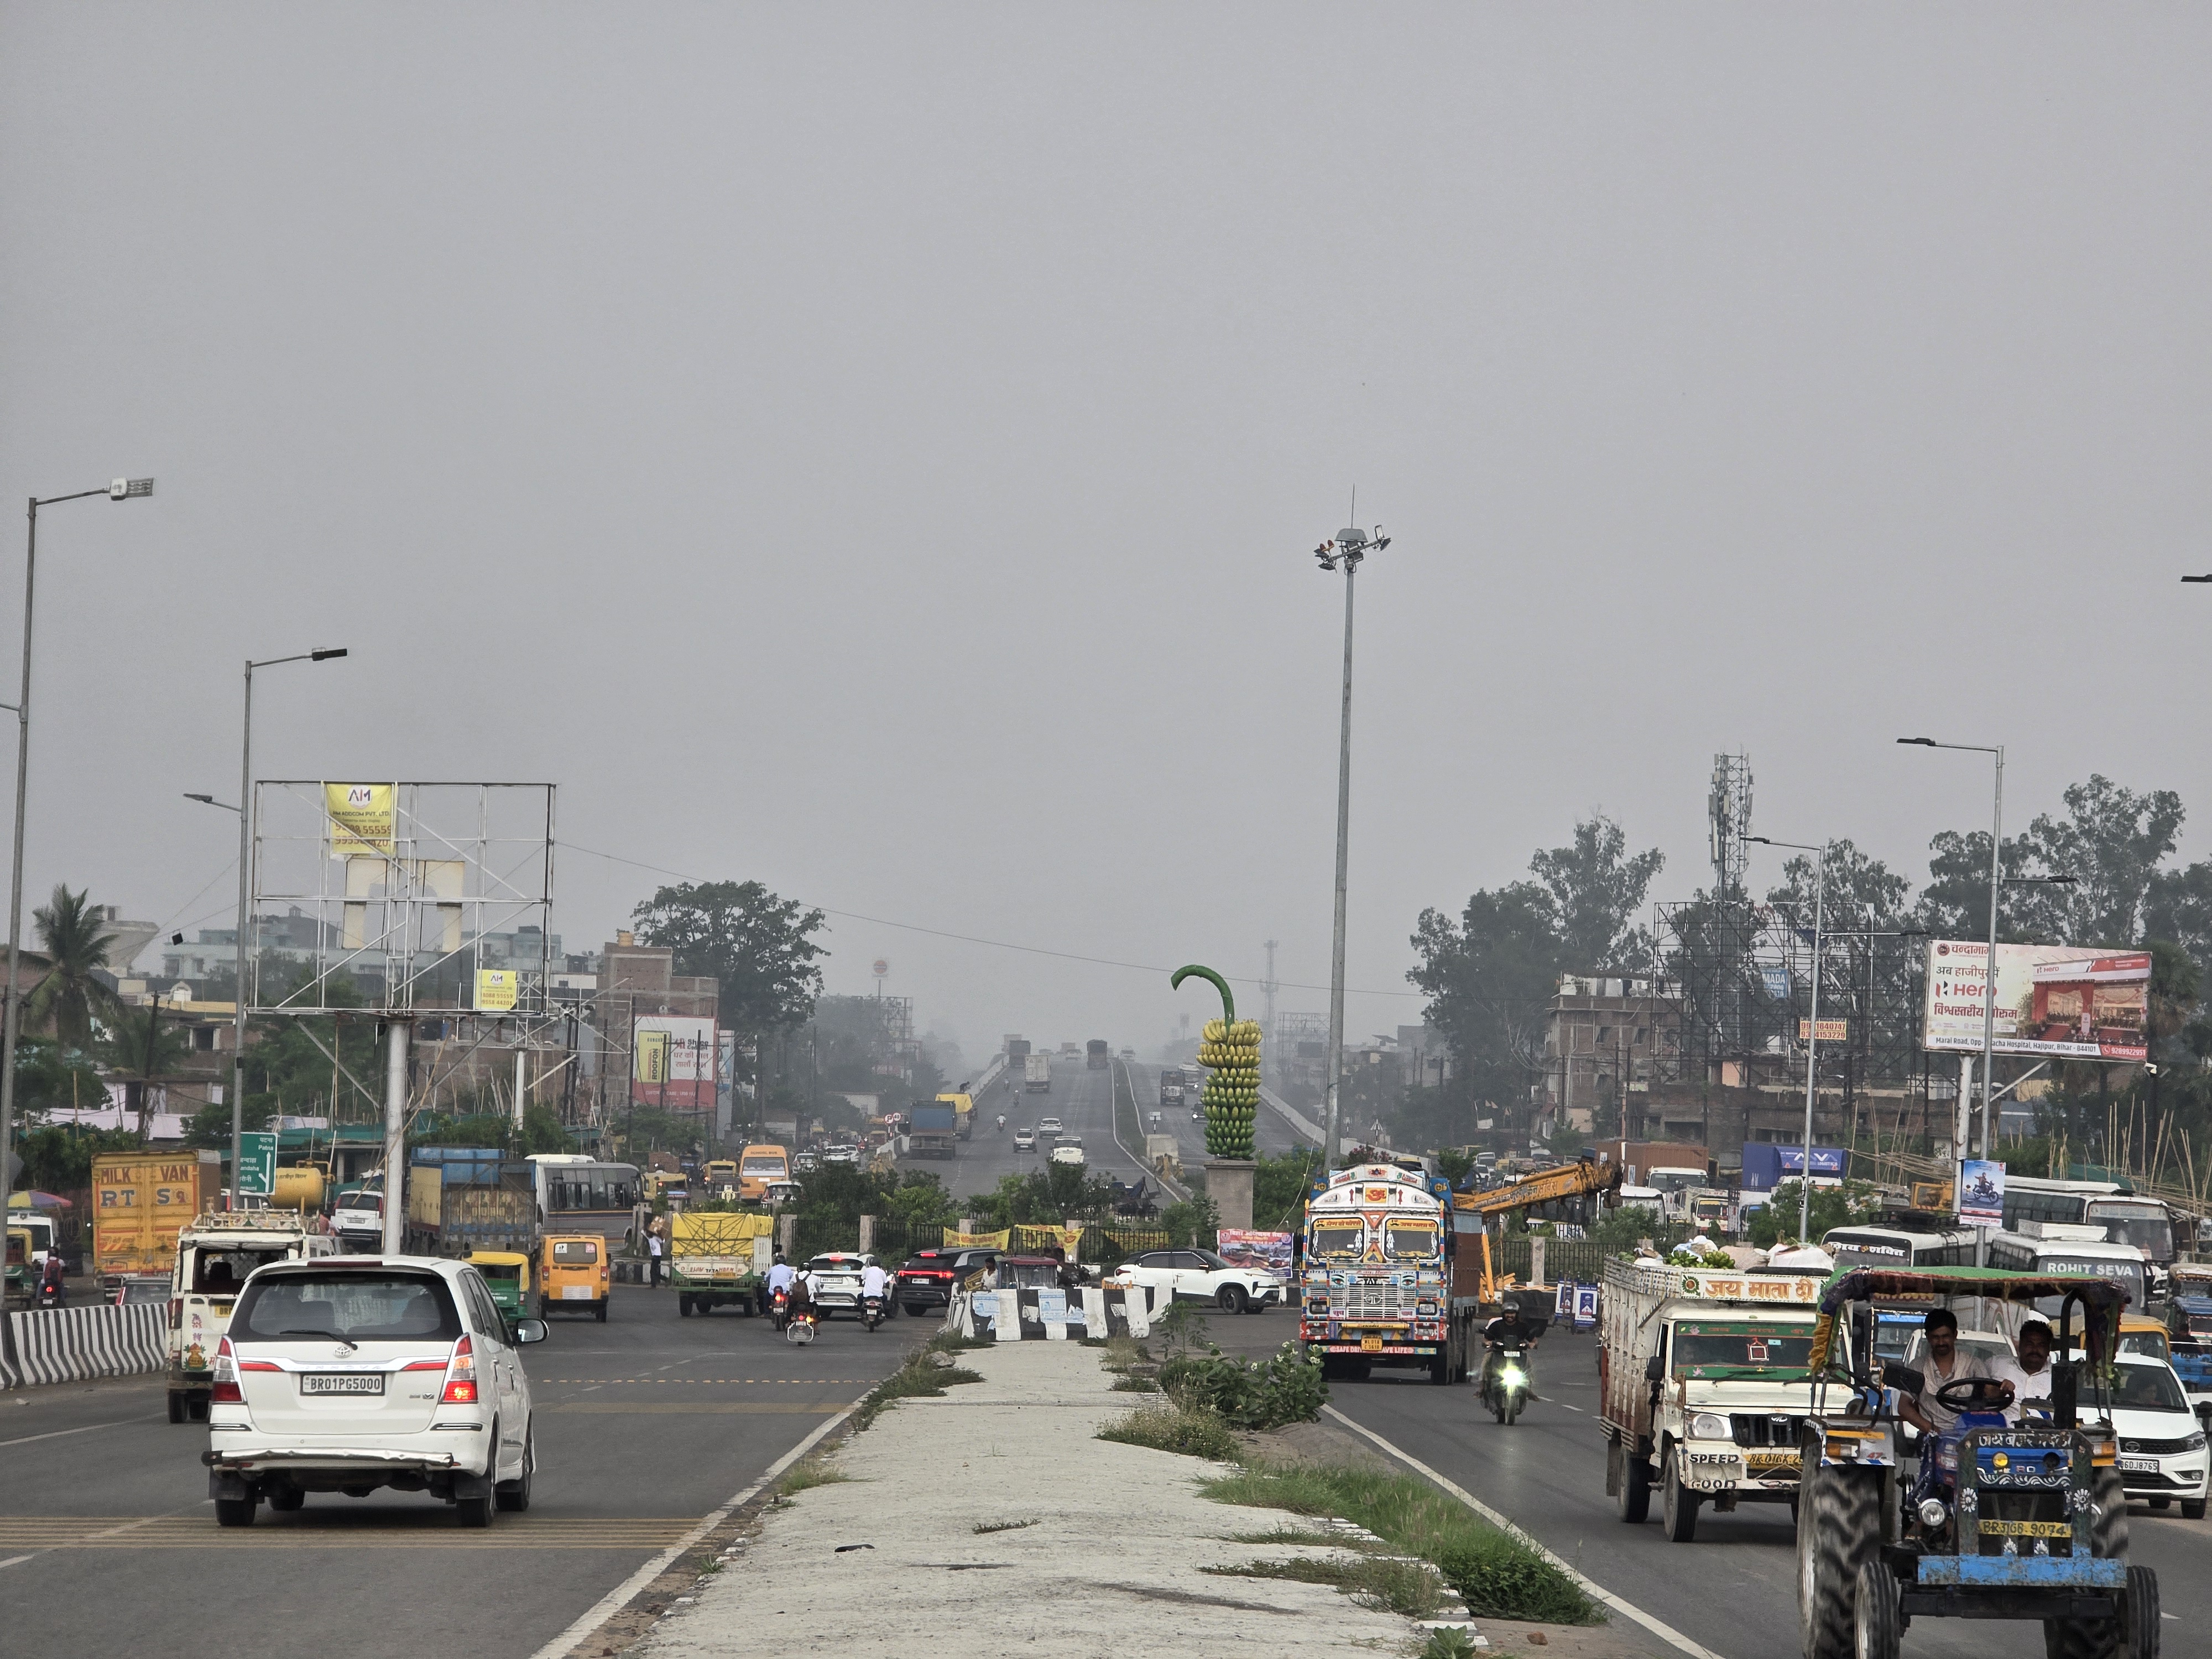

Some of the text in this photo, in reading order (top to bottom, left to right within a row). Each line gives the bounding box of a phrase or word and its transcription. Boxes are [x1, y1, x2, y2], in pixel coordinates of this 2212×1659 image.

[1936, 966, 1953, 975] अब
[2111, 1047, 2146, 1056] 9289922951
[101, 1164, 188, 1183] MILK VAN
[2047, 1262, 2133, 1276] ROHIT SEVA
[1705, 1277, 1817, 1303] जय माता दी
[310, 1378, 380, 1390] BR01PG5000
[1689, 1454, 1739, 1463] SPEED
[1692, 1479, 1736, 1489] GOOD
